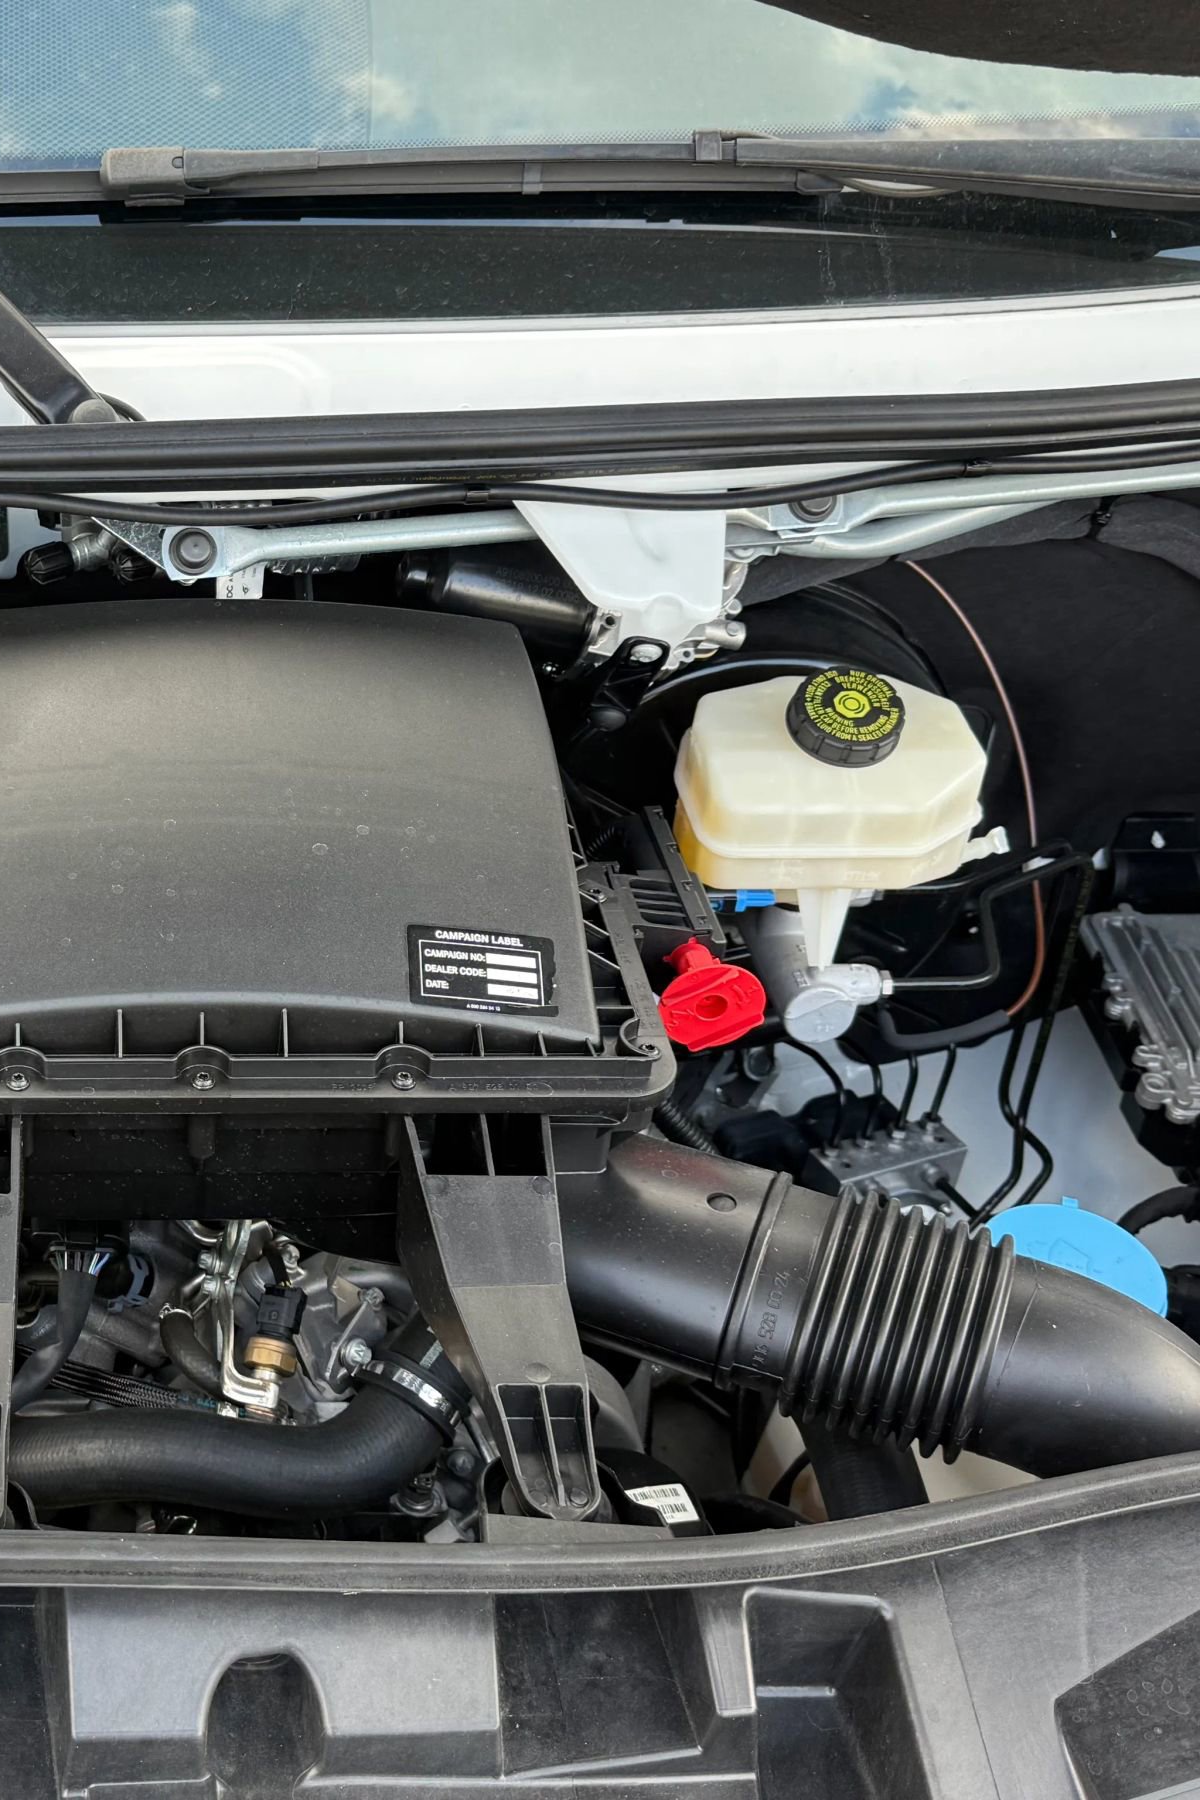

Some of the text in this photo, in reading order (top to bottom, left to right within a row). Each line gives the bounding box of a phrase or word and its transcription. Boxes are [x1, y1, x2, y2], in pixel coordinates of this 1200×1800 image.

[849, 670, 895, 698] NUR ORIGINAL
[814, 718, 832, 734] FLUID
[831, 729, 852, 741] FROM
[858, 729, 883, 741] SEALED
[880, 707, 899, 735] CONTAINER
[825, 707, 855, 727] WARNING
[831, 722, 858, 735] BEFORE
[859, 714, 889, 734] REMOVING
[435, 930, 524, 947] CAMPAIGN LABEL
[424, 948, 486, 962] CAMPAIGN NO:
[424, 963, 487, 978] DEALER CODE:
[425, 979, 449, 989] DATE:
